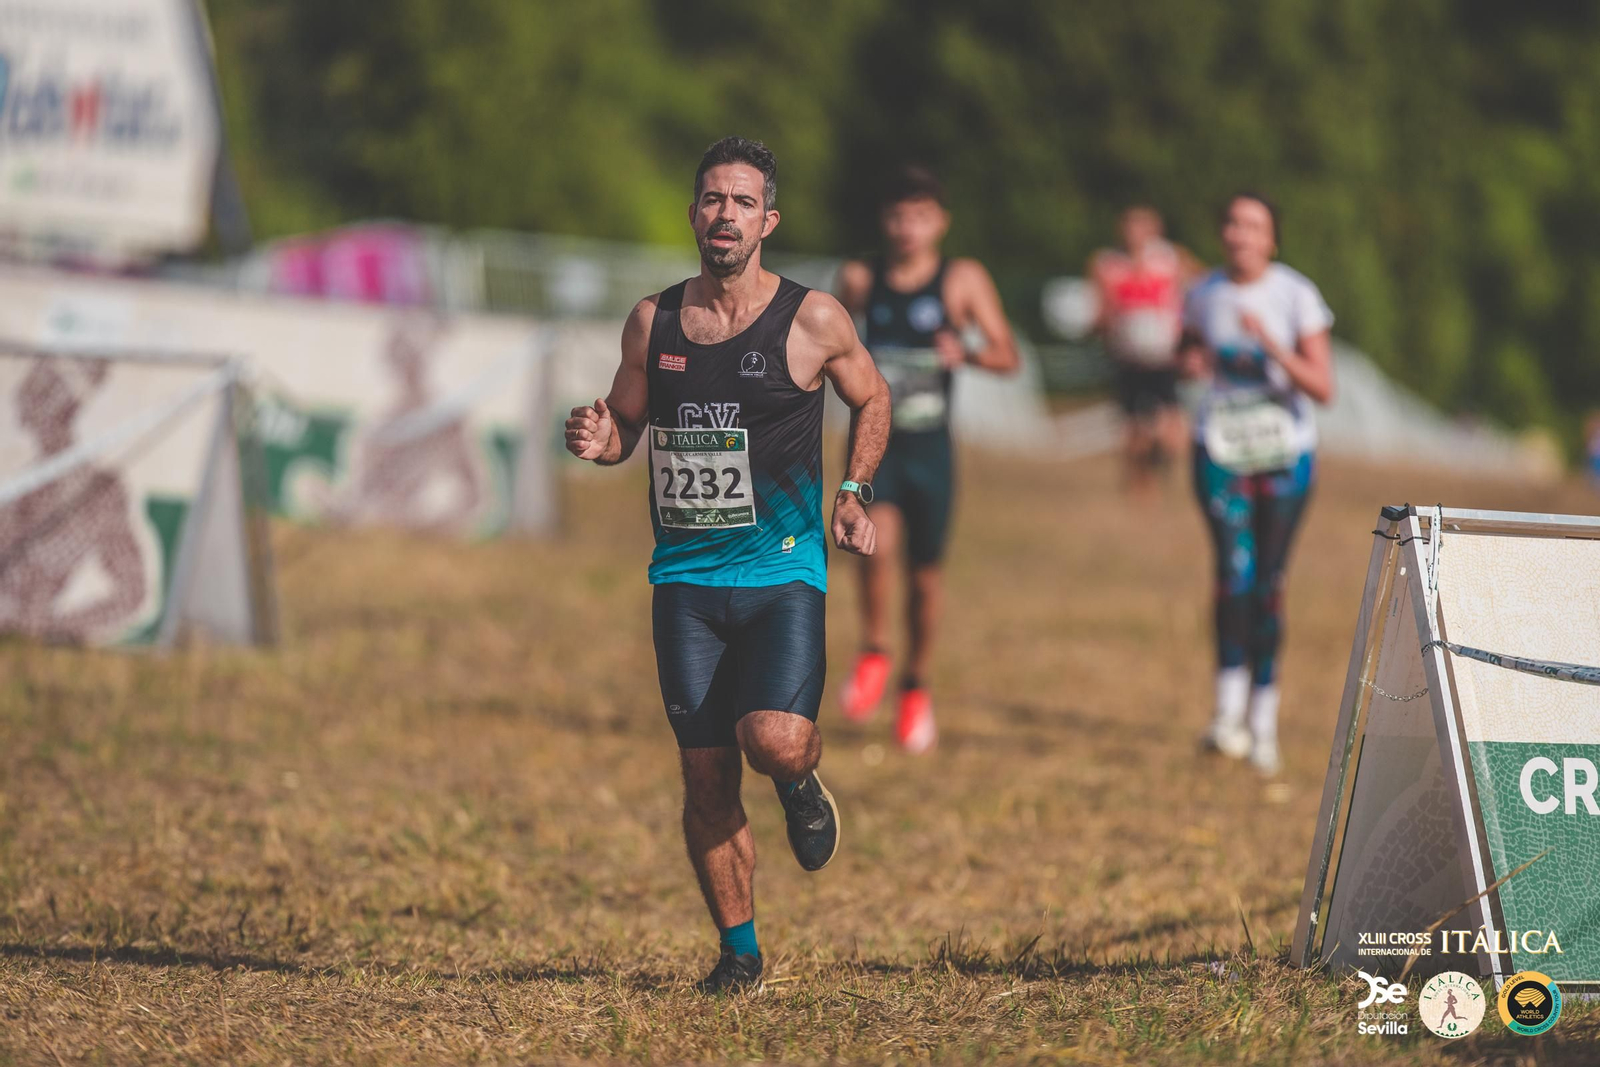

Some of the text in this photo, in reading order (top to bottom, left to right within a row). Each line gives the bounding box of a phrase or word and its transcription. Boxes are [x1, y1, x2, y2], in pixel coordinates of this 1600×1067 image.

[672, 432, 719, 446] ITÁLICA
[661, 467, 744, 499] 2232
[1520, 756, 1600, 815] CR
